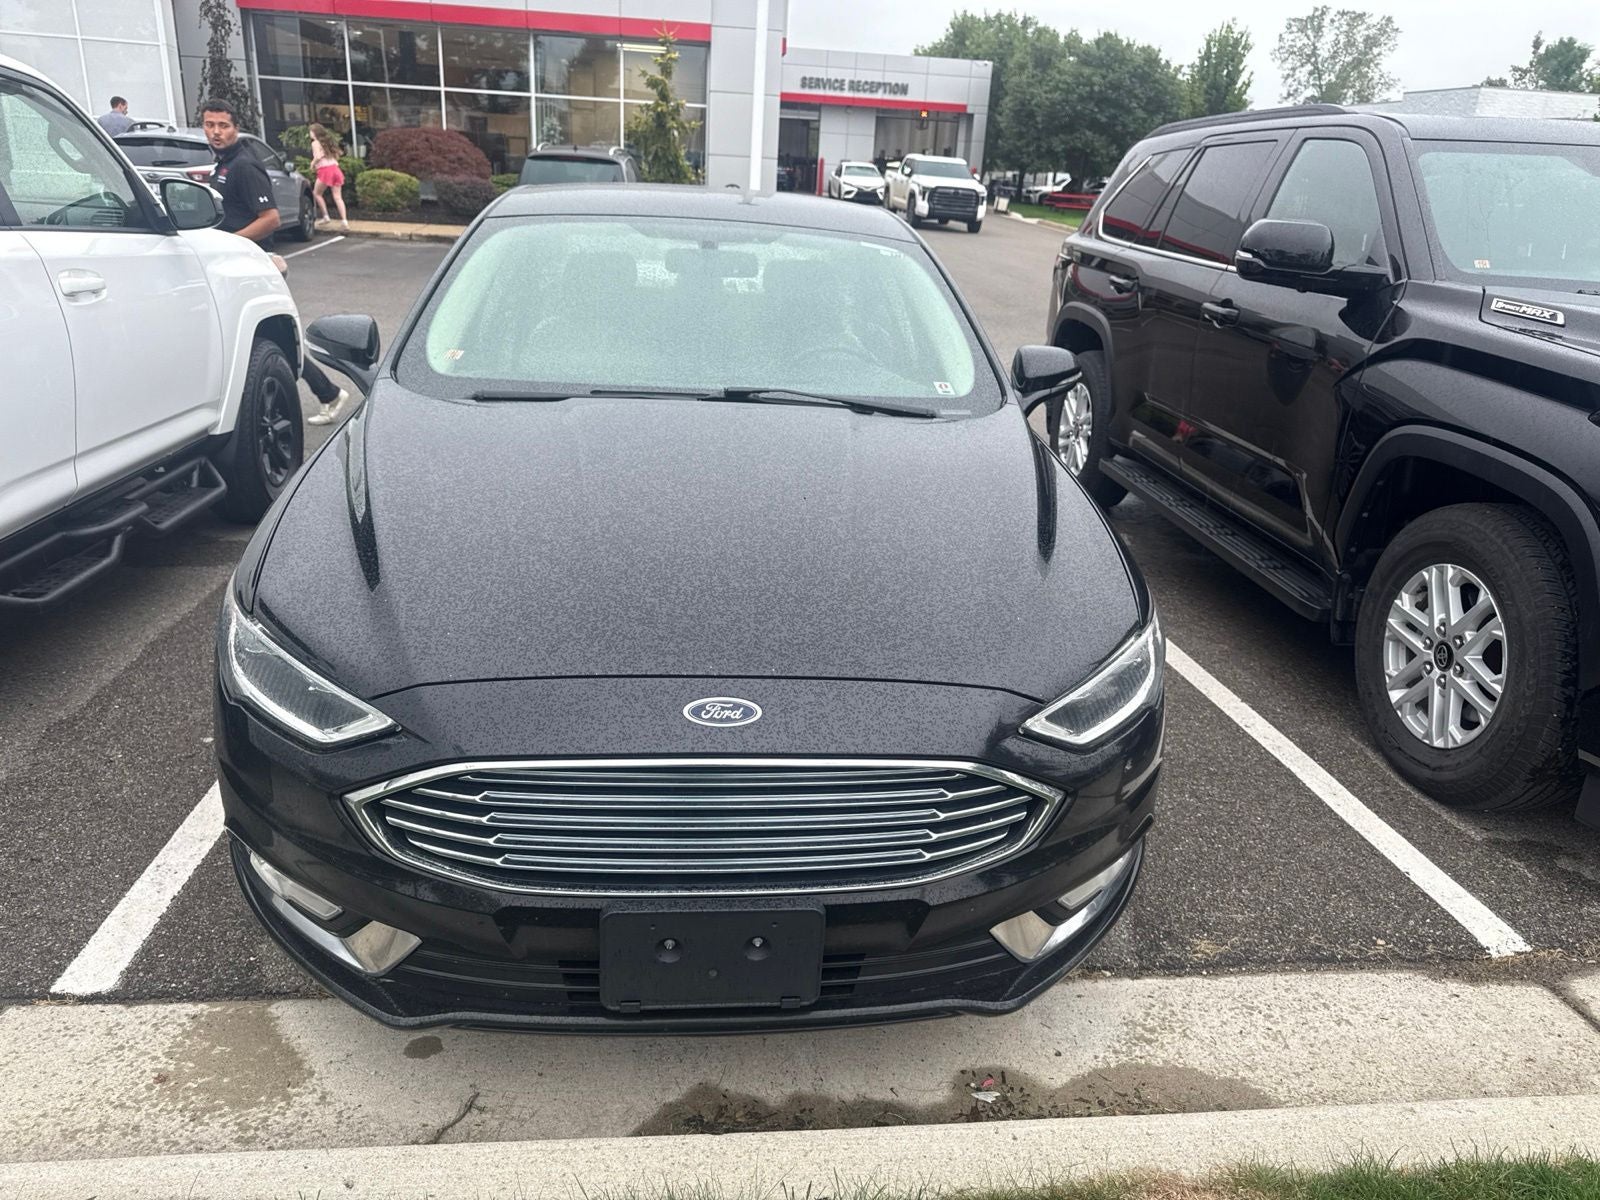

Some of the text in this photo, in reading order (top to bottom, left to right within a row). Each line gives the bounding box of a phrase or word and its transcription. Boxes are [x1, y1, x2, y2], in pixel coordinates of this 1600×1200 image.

[800, 76, 909, 96] SERVICE RECEPTION
[1519, 306, 1554, 319] MAX
[701, 702, 744, 720] Ford
